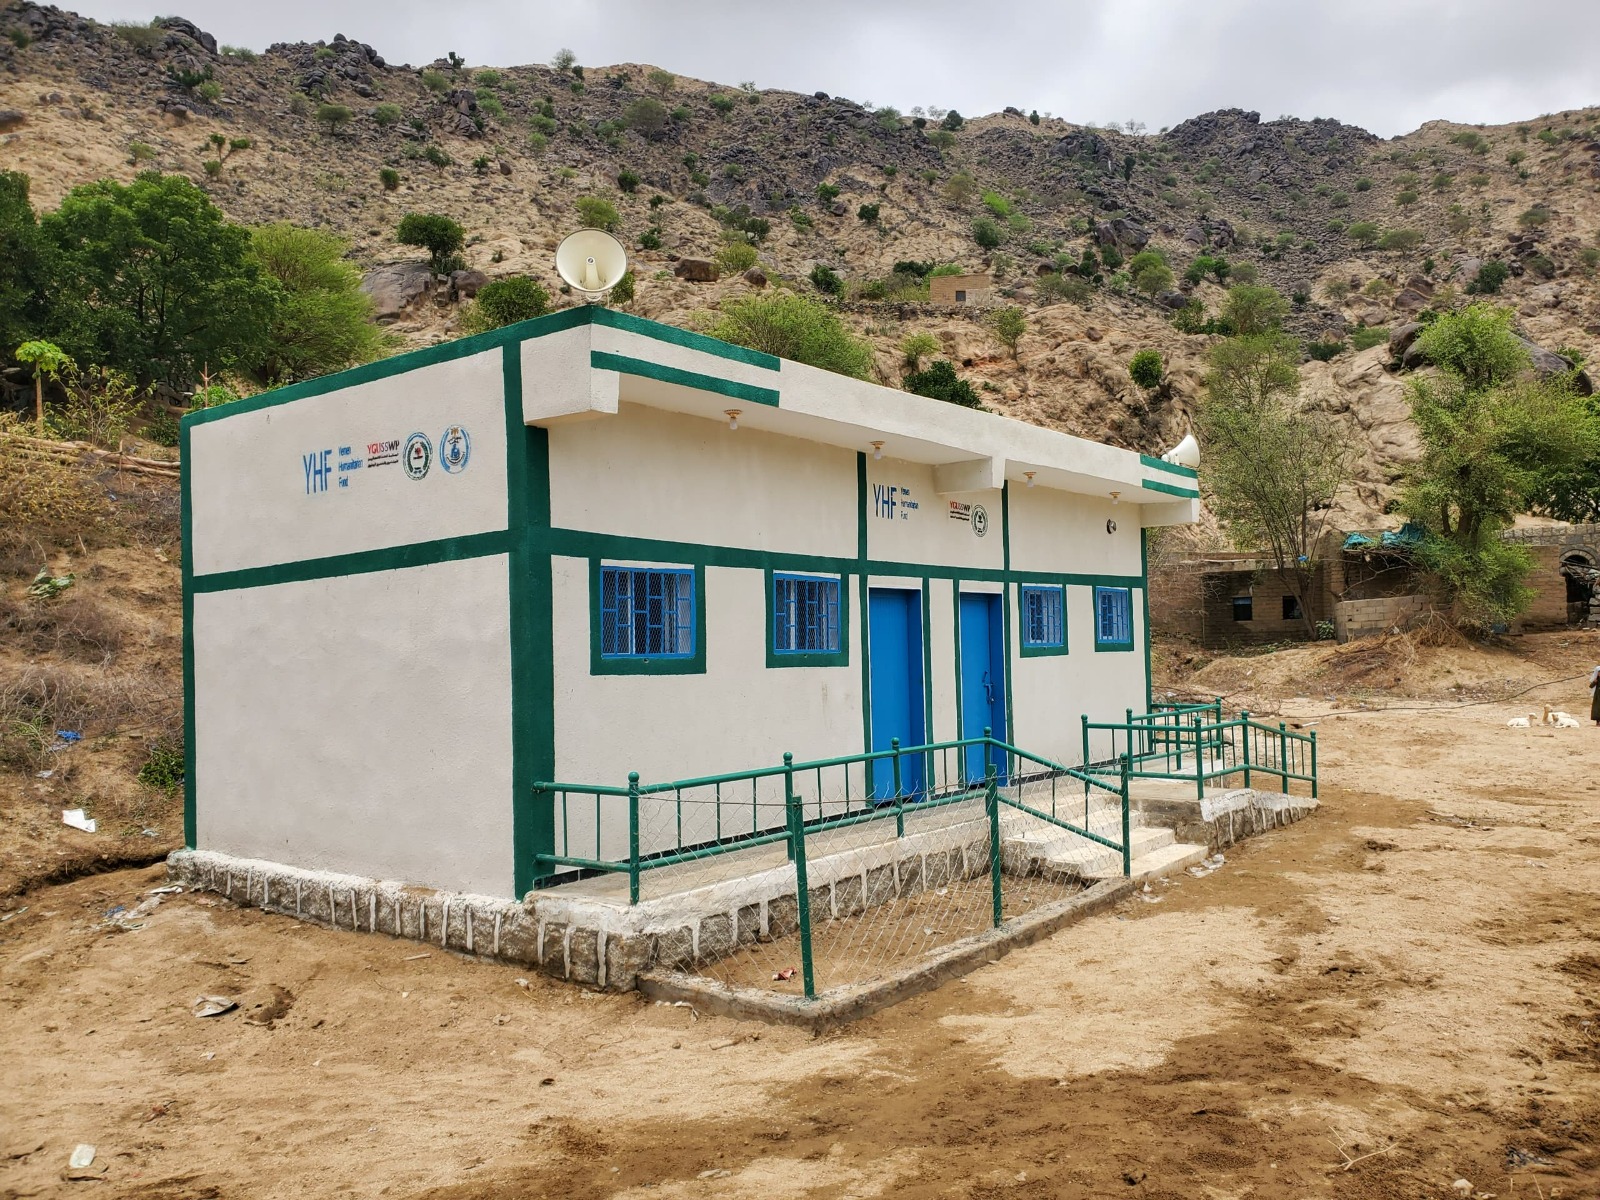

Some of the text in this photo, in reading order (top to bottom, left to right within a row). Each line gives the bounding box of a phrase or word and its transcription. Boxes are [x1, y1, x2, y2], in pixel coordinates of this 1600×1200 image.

[367, 440, 399, 454] YGUSSWP
[303, 449, 332, 494] YHF
[873, 483, 897, 519] YHF
